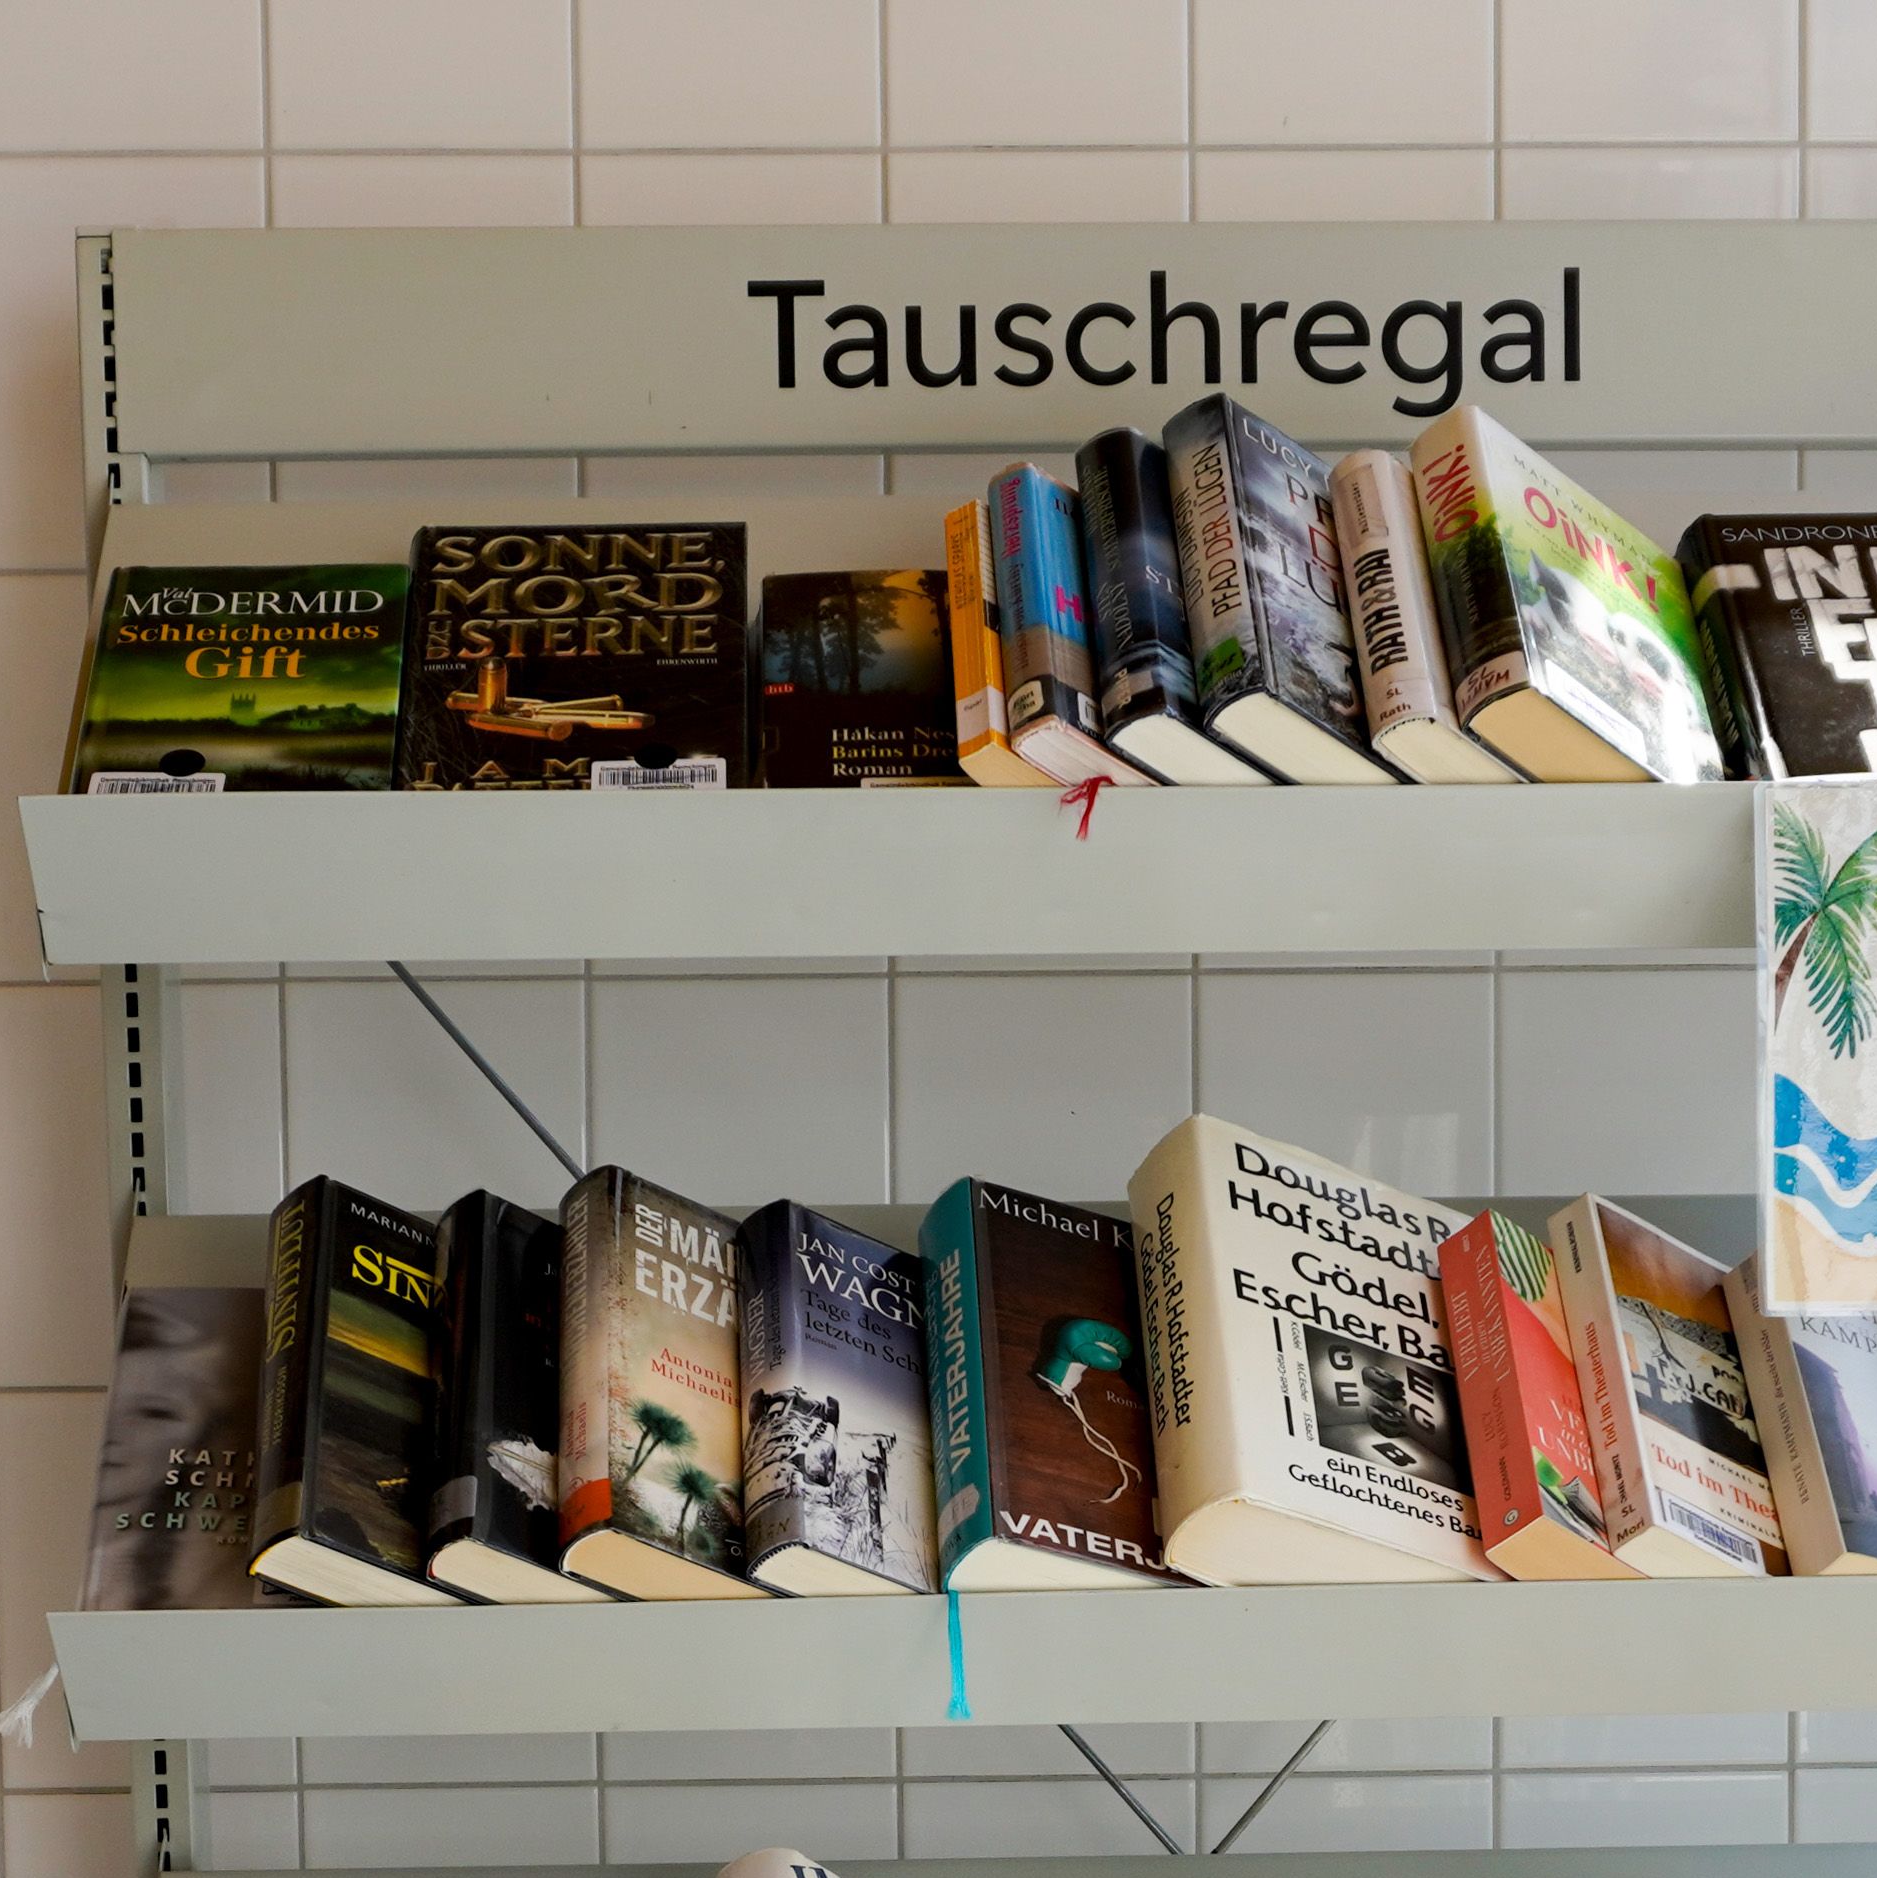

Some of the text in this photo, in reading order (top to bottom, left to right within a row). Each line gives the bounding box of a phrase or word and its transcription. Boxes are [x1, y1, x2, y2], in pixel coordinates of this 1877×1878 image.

[747, 267, 1581, 416] Tauschregal
[432, 532, 725, 572] SONNE,
[1763, 544, 1866, 600] IN
[122, 589, 384, 618] McDERMID
[428, 573, 722, 615] MORD
[117, 622, 380, 645] Schleichendes
[458, 615, 718, 658] STERNE
[1791, 607, 1815, 656] THRILLER
[184, 646, 307, 679] Gift
[831, 725, 905, 742] Håkan
[831, 744, 904, 760] Barins
[832, 762, 913, 776] Roman
[1234, 1142, 1422, 1236] Douglas
[979, 1189, 1100, 1241] Michael
[797, 1231, 845, 1266] JAN
[800, 1288, 893, 1340] Tage des
[804, 1312, 878, 1356] letzten
[940, 1247, 972, 1474] VATERJAHRE
[1327, 1457, 1464, 1512] ein Endloses
[1652, 1442, 1724, 1492] Tod im
[1289, 1463, 1444, 1527] Geflochtenes
